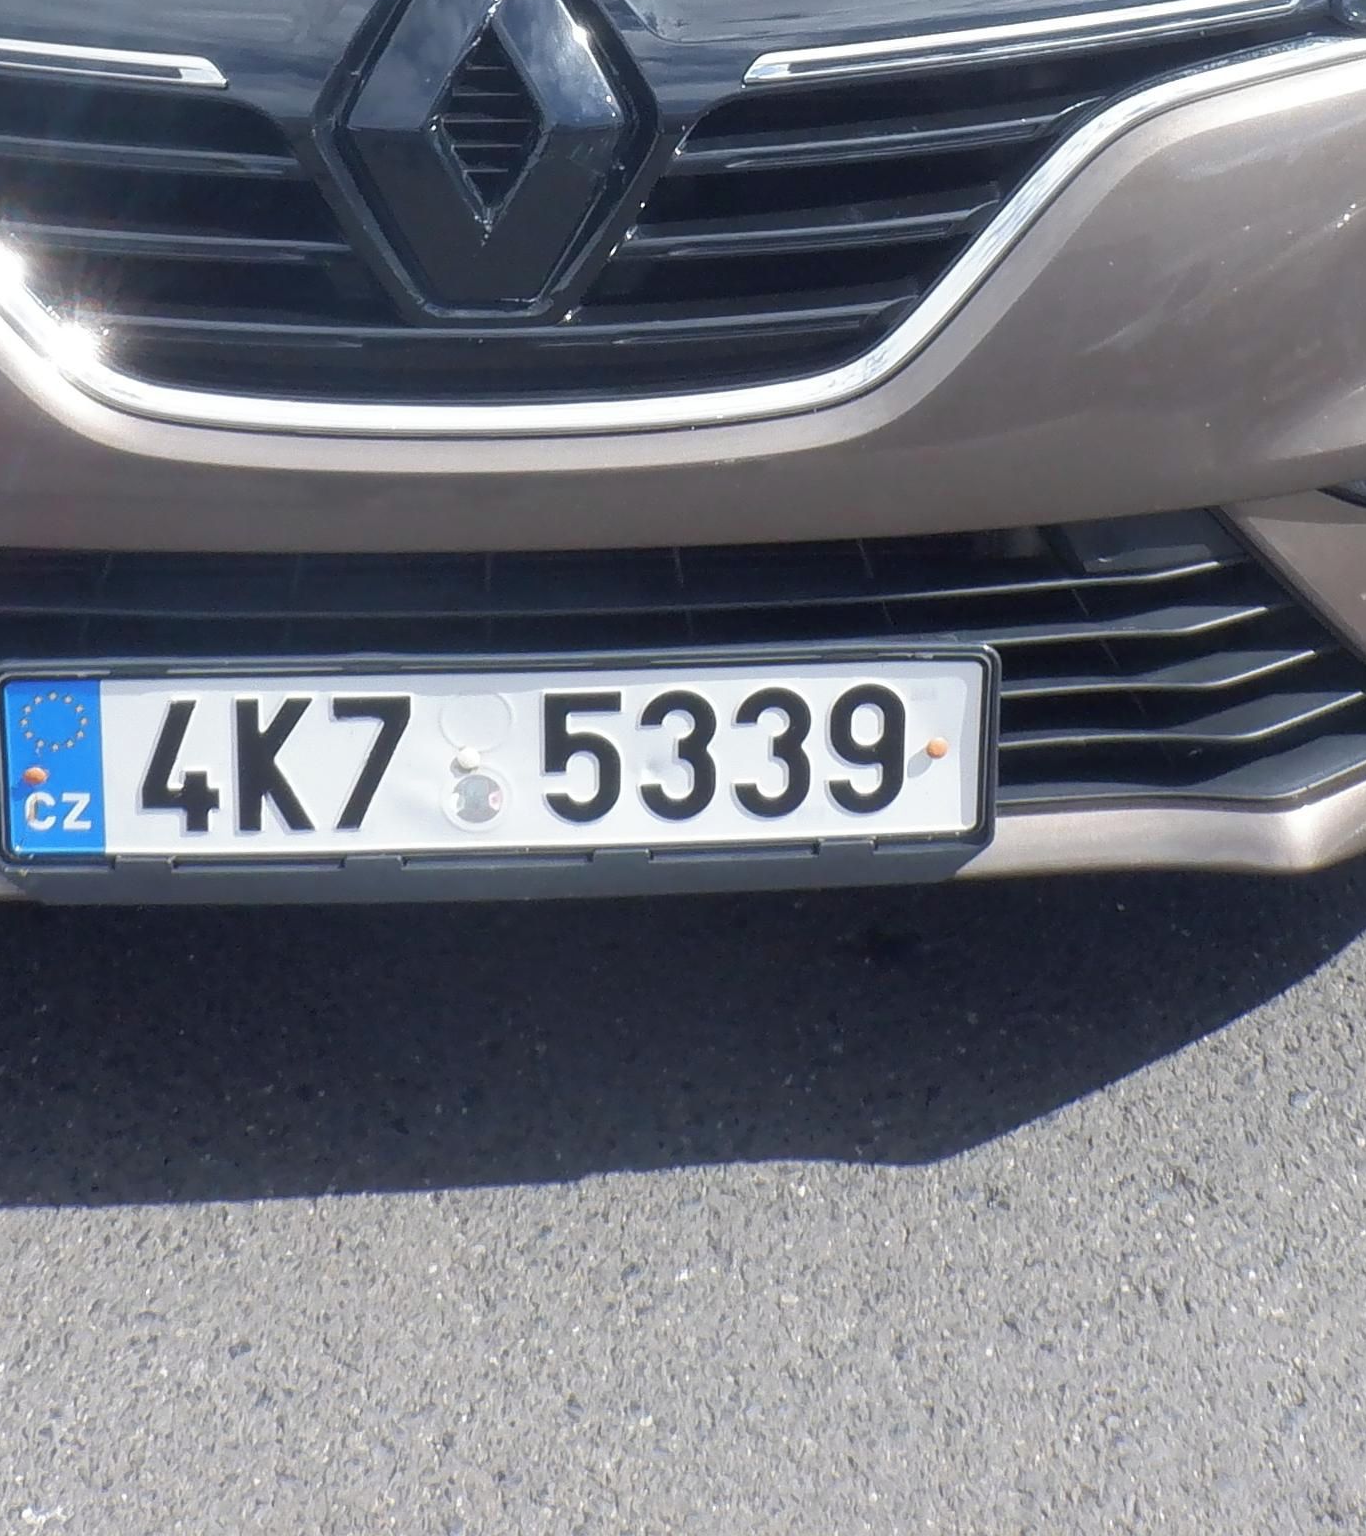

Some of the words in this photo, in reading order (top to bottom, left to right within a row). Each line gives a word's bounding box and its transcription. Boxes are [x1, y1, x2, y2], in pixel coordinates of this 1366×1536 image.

[140, 696, 412, 834] 4K7
[542, 682, 906, 823] 5339
[24, 791, 91, 831] CZ
